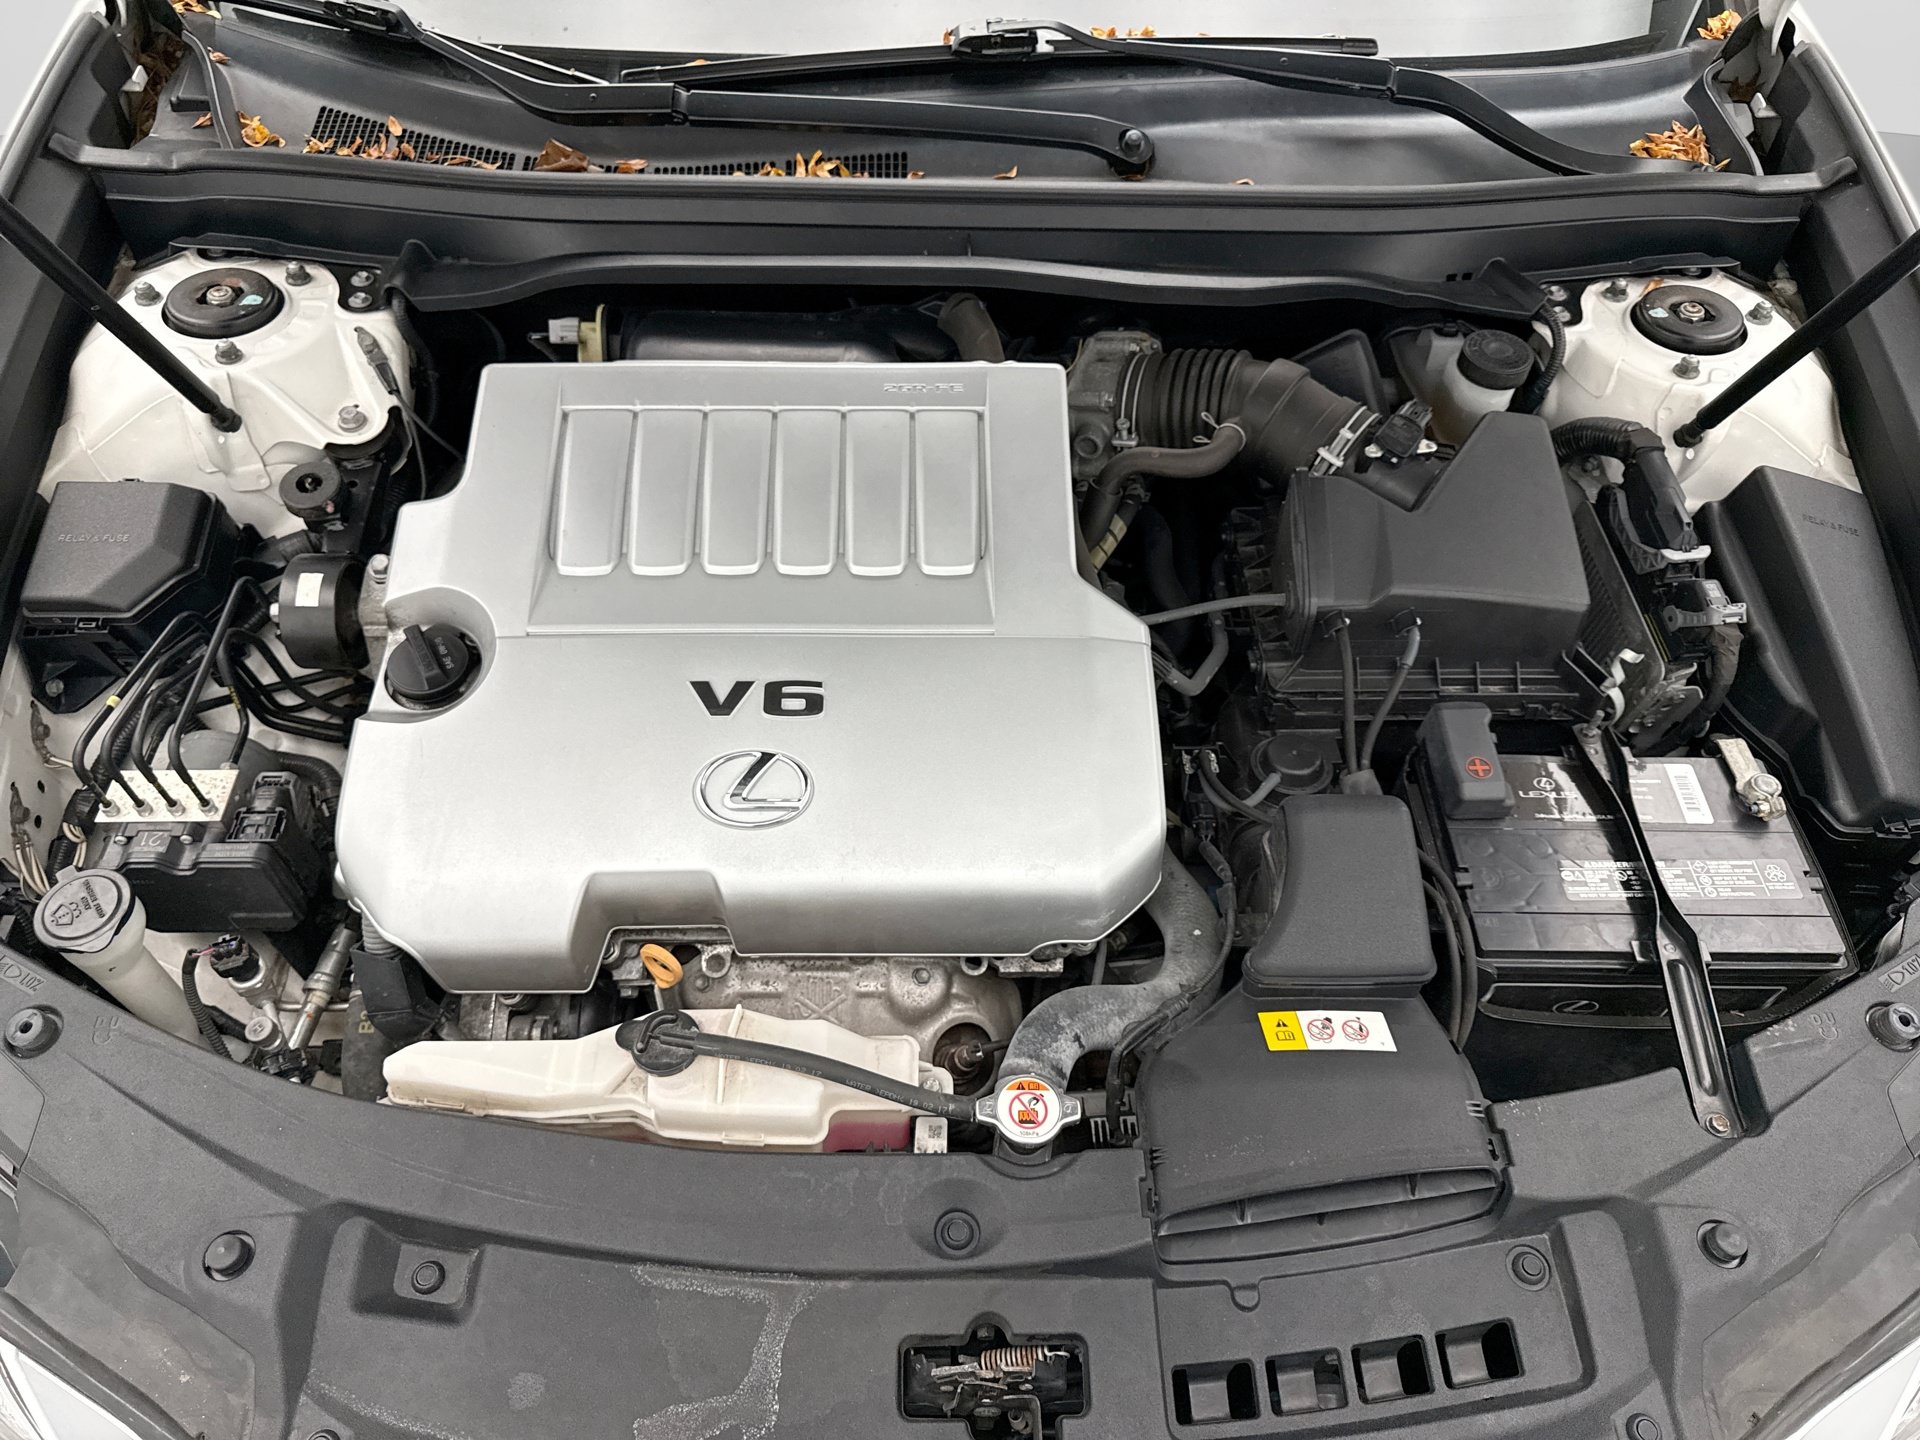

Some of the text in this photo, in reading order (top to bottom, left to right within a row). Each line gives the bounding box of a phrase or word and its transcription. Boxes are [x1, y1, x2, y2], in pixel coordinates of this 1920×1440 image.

[883, 383, 964, 393] 2GR-FE
[58, 534, 92, 543] RELAY
[102, 534, 130, 542] FUSE
[688, 679, 825, 718] V6
[1519, 790, 1578, 799] LEXUS
[140, 831, 165, 846] 21
[20, 973, 45, 992] 1.0%
[846, 1080, 873, 1091] WATER
